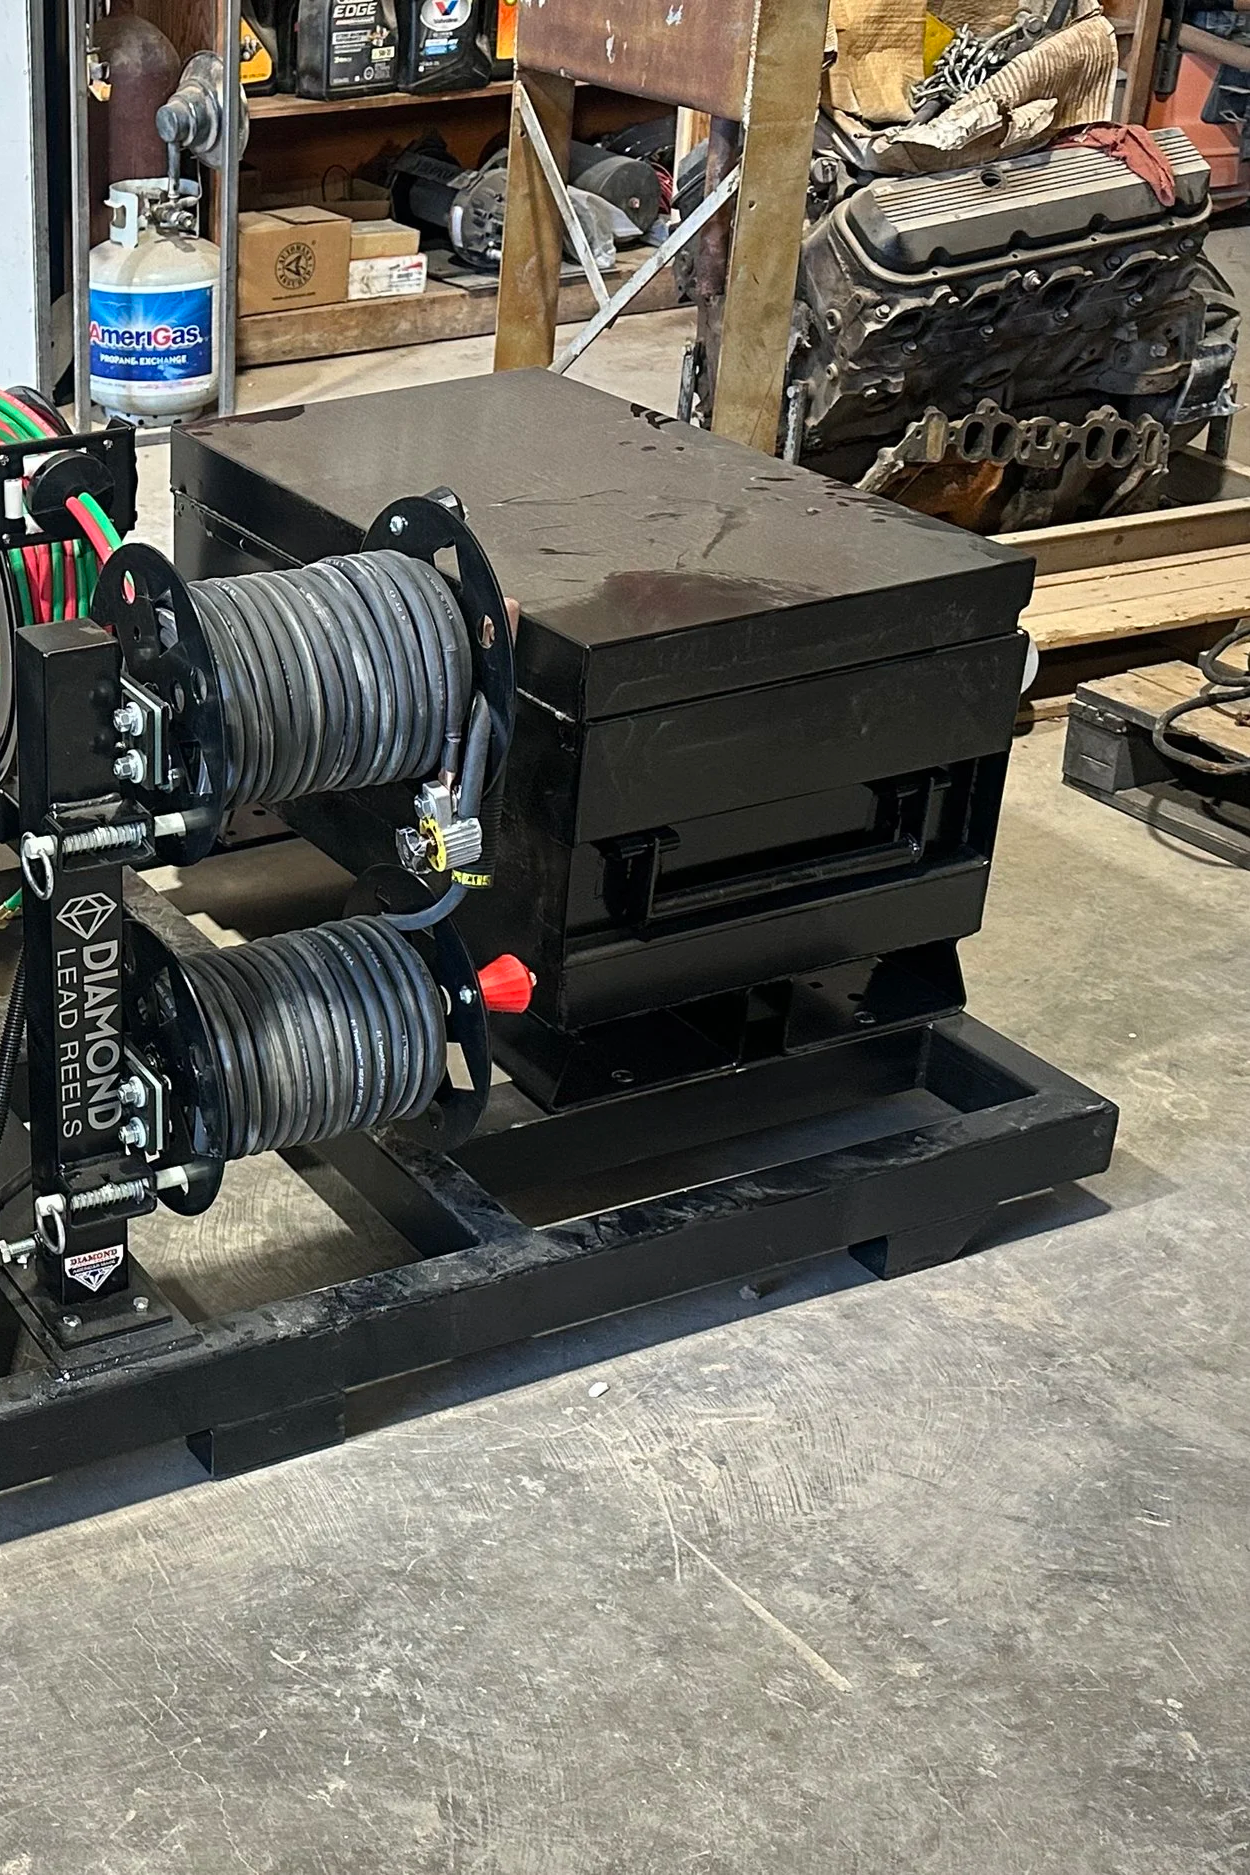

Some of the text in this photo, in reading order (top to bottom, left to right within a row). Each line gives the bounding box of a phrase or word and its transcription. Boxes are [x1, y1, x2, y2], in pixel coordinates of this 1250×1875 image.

[333, 2, 378, 18] EDGE
[89, 321, 200, 347] AmeriGas
[100, 353, 187, 366] PROPANE EXCHANGE
[56, 948, 82, 1139] LEAD REELS
[82, 939, 121, 1131] DIAMOND
[70, 1248, 118, 1266] DIAMOND
